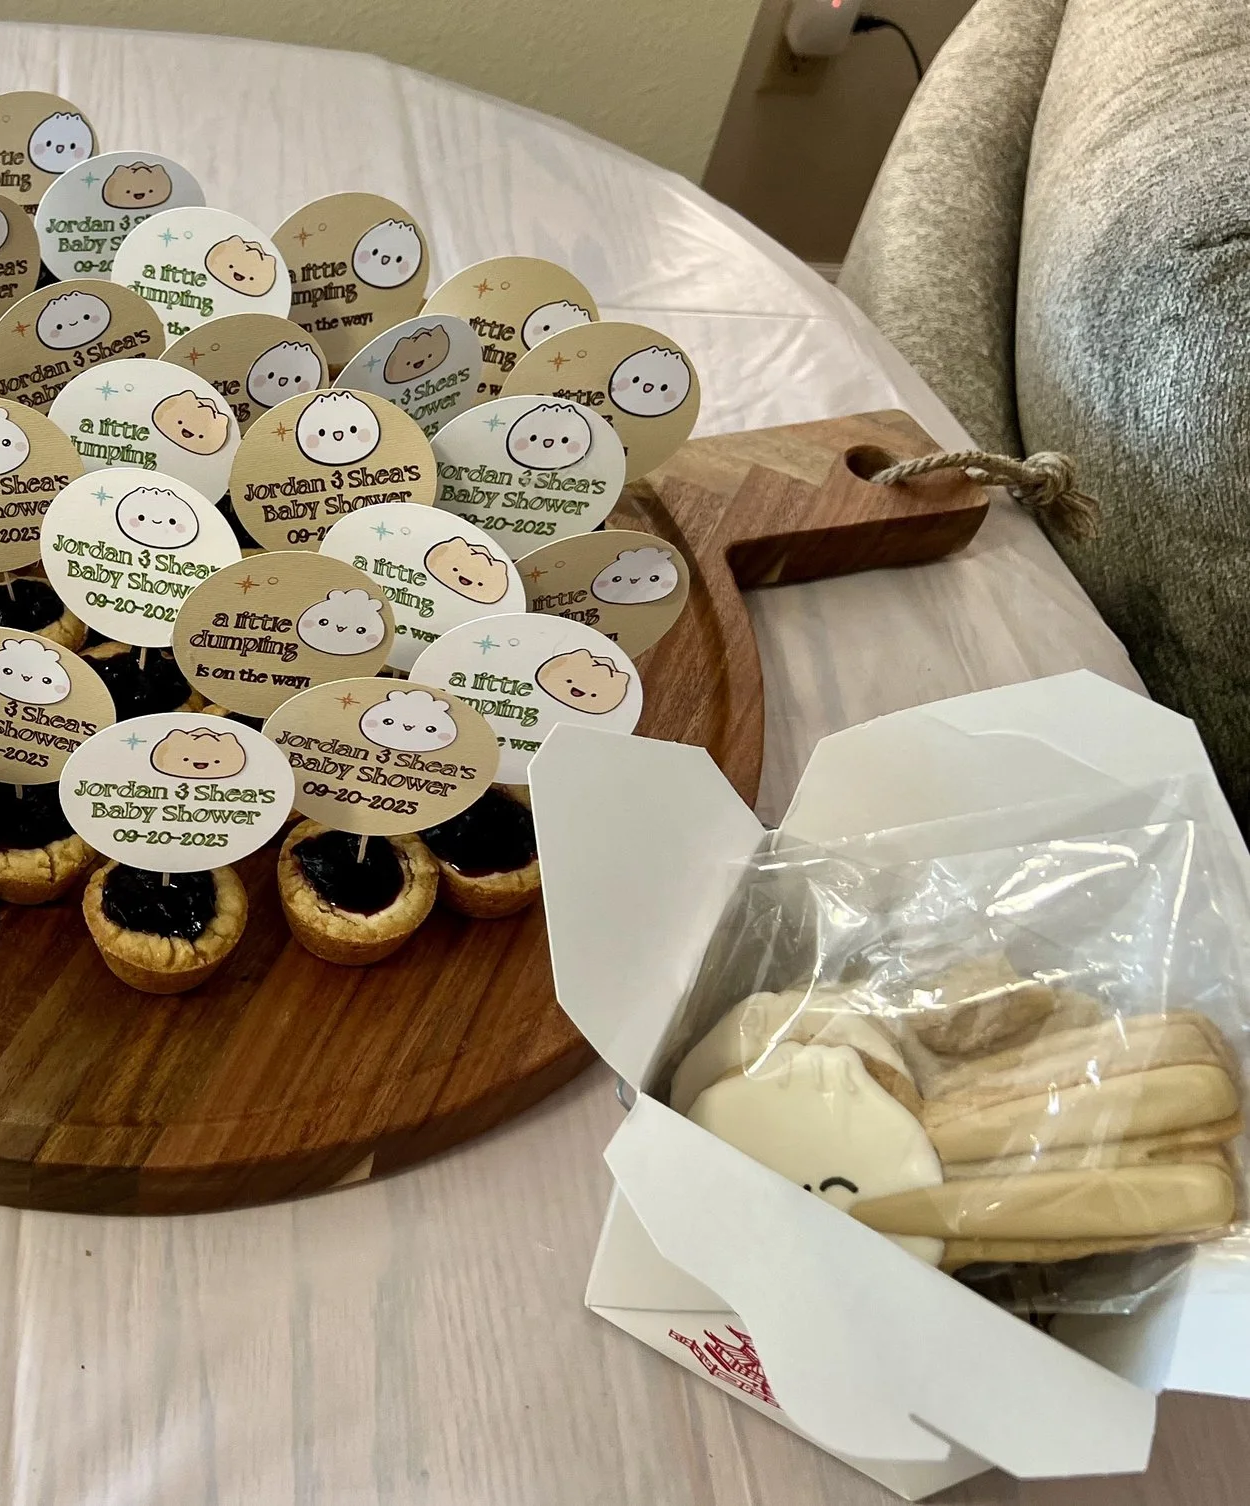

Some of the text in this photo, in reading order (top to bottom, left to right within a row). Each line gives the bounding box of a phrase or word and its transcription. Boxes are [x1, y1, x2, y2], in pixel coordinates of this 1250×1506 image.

[46, 216, 115, 234] Jordan
[58, 235, 107, 254] Baby
[142, 265, 208, 287] a little
[301, 262, 347, 282] little
[315, 316, 338, 330] the
[0, 361, 71, 395] Jordan
[87, 330, 151, 363] Shea's
[415, 368, 470, 401] Shea's
[79, 418, 150, 441] a little
[0, 475, 70, 496] Shea's
[244, 476, 326, 501] Jordan
[347, 465, 421, 492] Shea's
[534, 472, 606, 494] Shea's
[262, 497, 319, 522] Baby
[440, 485, 590, 515] Baby Shower
[52, 534, 133, 566] Jordan
[67, 562, 124, 590] Baby
[352, 555, 427, 586] a little
[85, 591, 179, 623] 09-20-202
[212, 612, 292, 632] a little
[190, 630, 298, 662] dumpling
[195, 664, 209, 677] is
[212, 668, 234, 680] on
[239, 669, 268, 684] the
[449, 672, 533, 697] a little
[22, 706, 97, 736] Shea's
[275, 731, 370, 761] Jordan
[394, 752, 477, 780] Shea's
[288, 751, 457, 798] Baby Shower
[75, 780, 169, 800] Jordan
[194, 783, 276, 804] Shea's
[302, 781, 419, 815] 09-20-2025
[91, 802, 261, 825] Baby Shower
[113, 829, 229, 848] 09-20-2025
